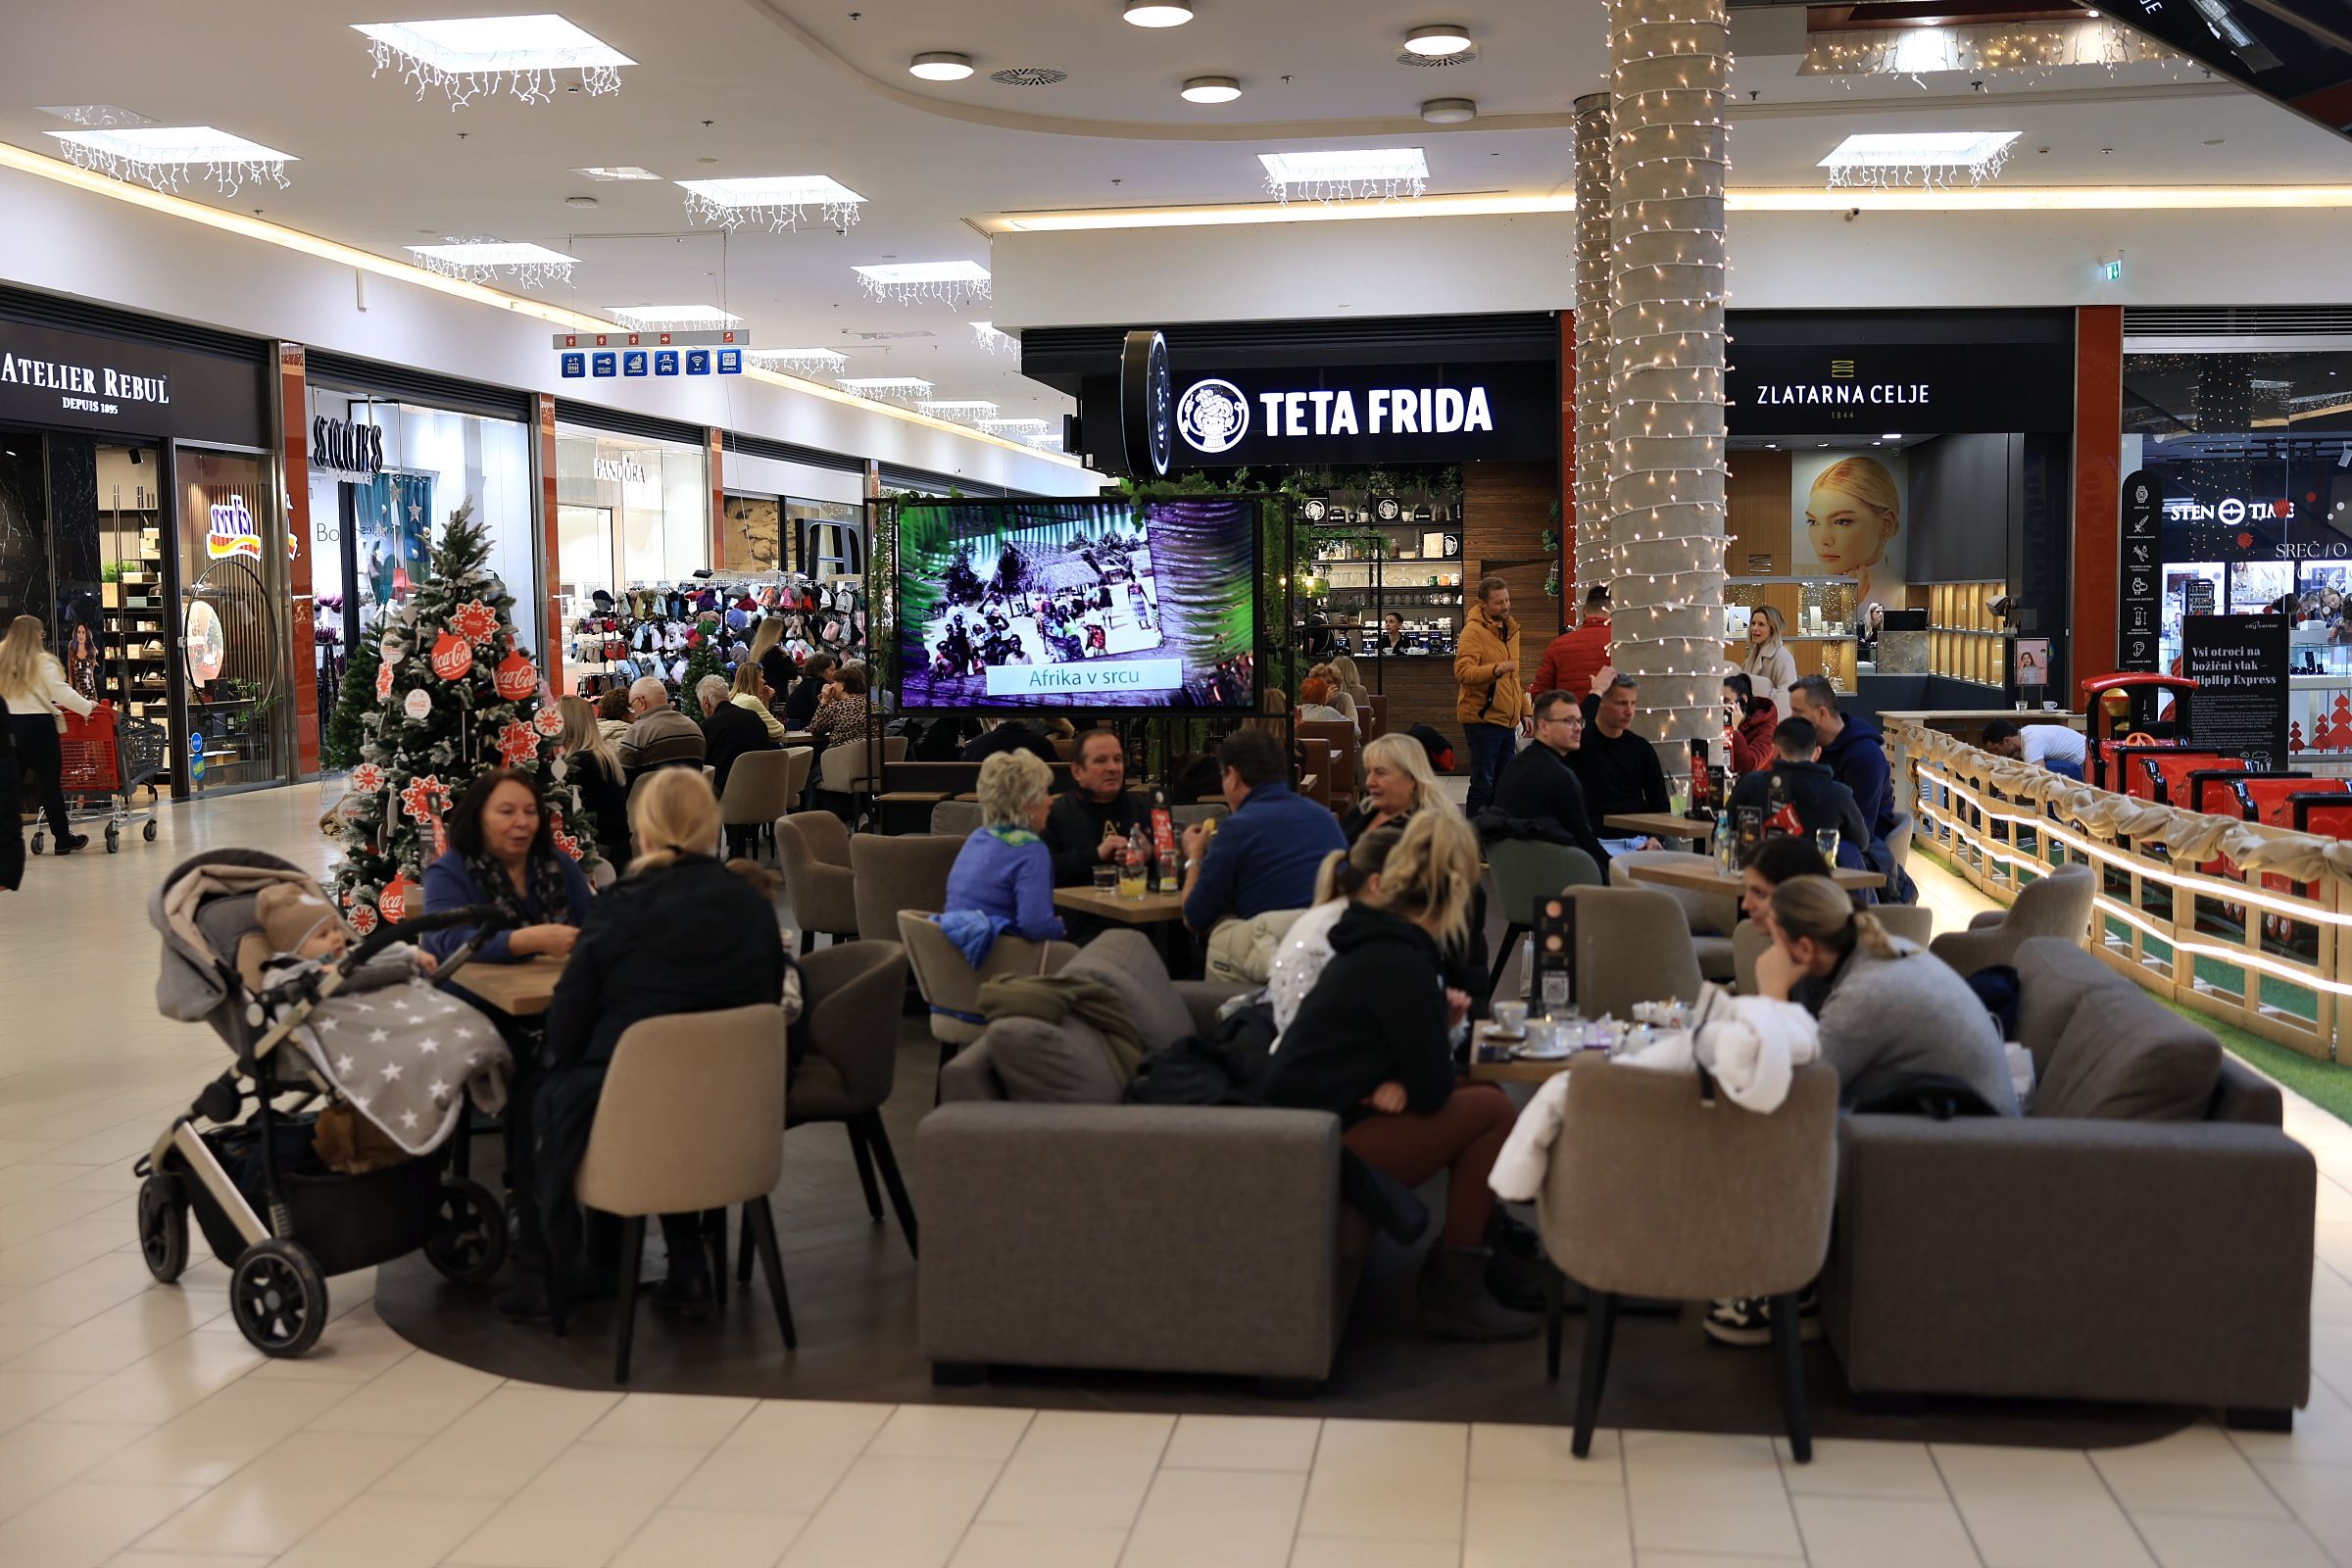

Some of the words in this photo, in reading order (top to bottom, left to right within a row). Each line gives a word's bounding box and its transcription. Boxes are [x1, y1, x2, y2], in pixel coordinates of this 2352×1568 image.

[1, 353, 96, 394] ATELIER
[103, 368, 170, 404] REBUL
[1757, 385, 1865, 405] ZLATARNA
[1870, 384, 1930, 404] CELJE
[62, 397, 99, 413] DEPUIS
[100, 403, 119, 415] 1895
[1259, 390, 1359, 436] TETA
[1368, 386, 1494, 433] FRIDA
[313, 415, 383, 475] SOCKS
[597, 459, 645, 483] PANDORA
[2171, 504, 2215, 520] STEN
[2191, 647, 2209, 657] Vsi
[2211, 646, 2244, 657] otroci
[2246, 648, 2261, 657] na
[2191, 660, 2231, 671] božični
[2234, 660, 2258, 670] vlak
[1029, 668, 1082, 687] Afrika
[1087, 672, 1098, 684] v
[1102, 670, 1140, 684] srcu
[2192, 674, 2231, 687] HipHip
[2233, 674, 2278, 687] Express
